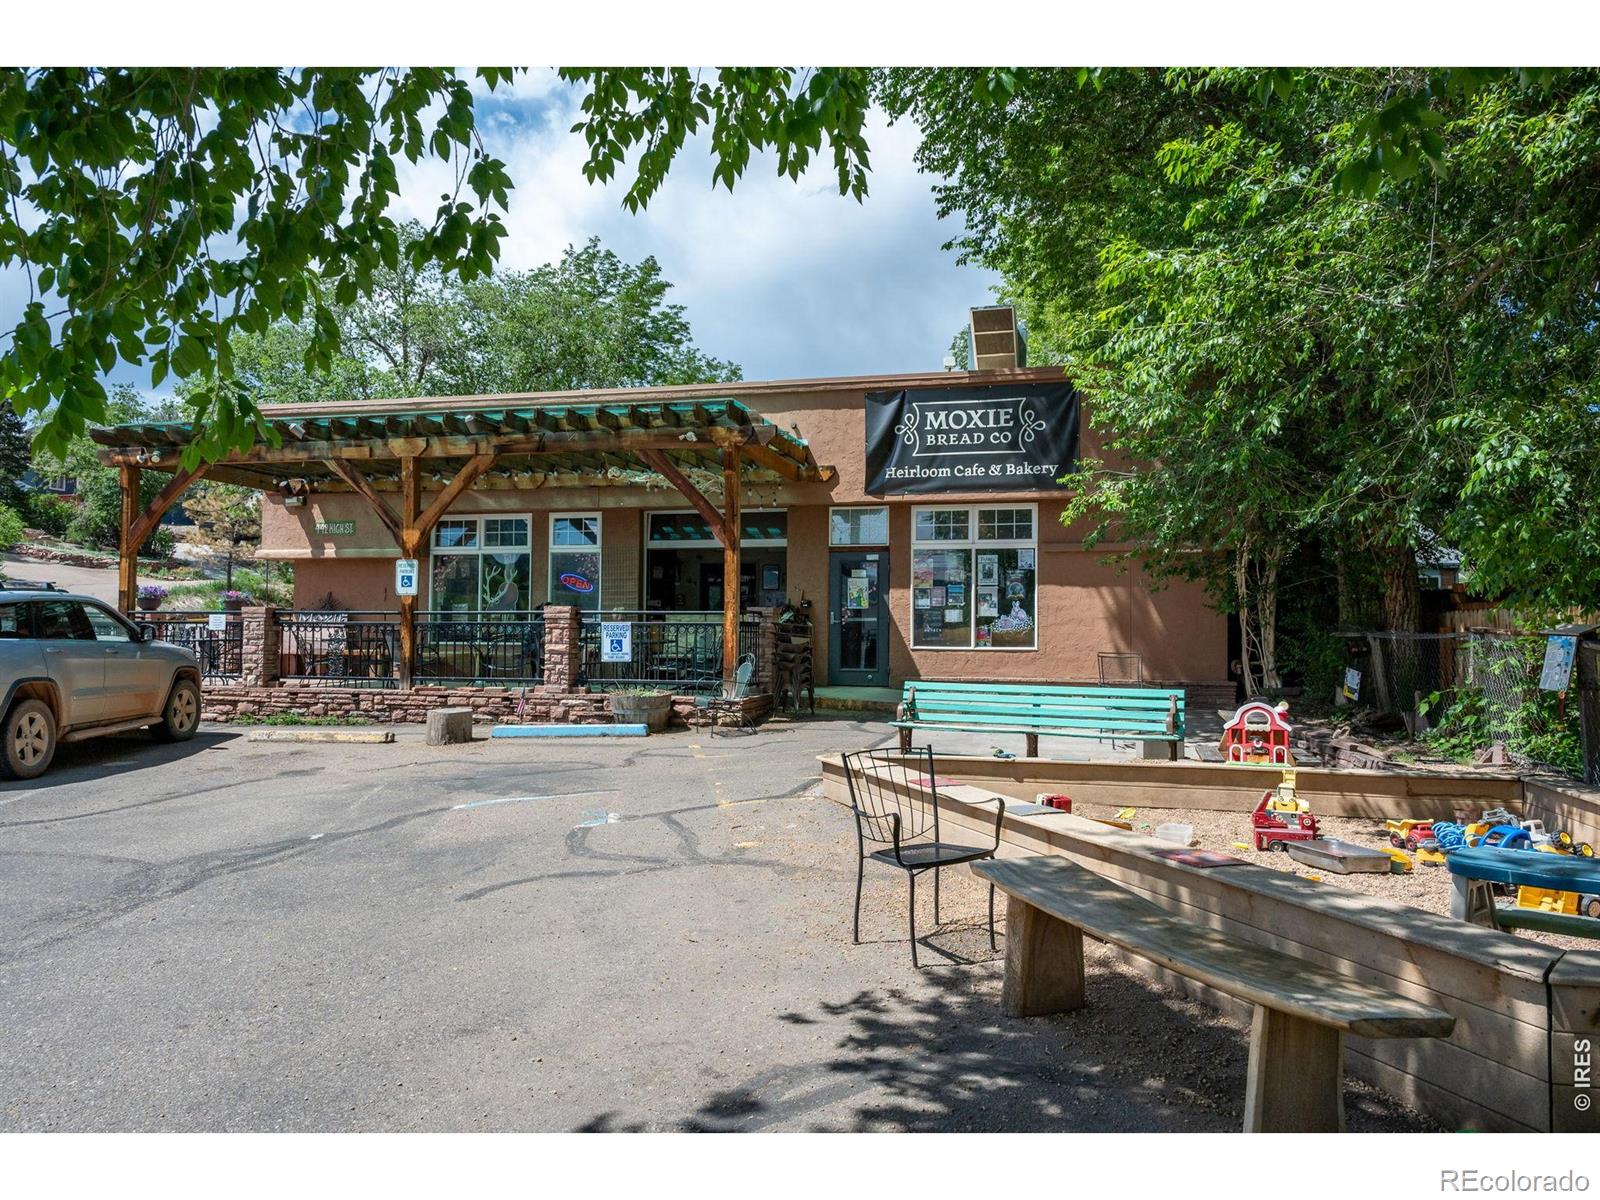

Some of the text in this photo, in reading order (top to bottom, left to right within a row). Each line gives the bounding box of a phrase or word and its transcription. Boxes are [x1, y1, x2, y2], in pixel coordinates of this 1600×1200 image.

[924, 408, 1014, 430] MOXIE
[926, 431, 1012, 446] BREAD CO
[885, 461, 1059, 479] Heirloom Cafe & Bakery
[329, 523, 344, 534] HIGH
[561, 576, 590, 589] OPEN
[605, 631, 628, 639] PARKING
